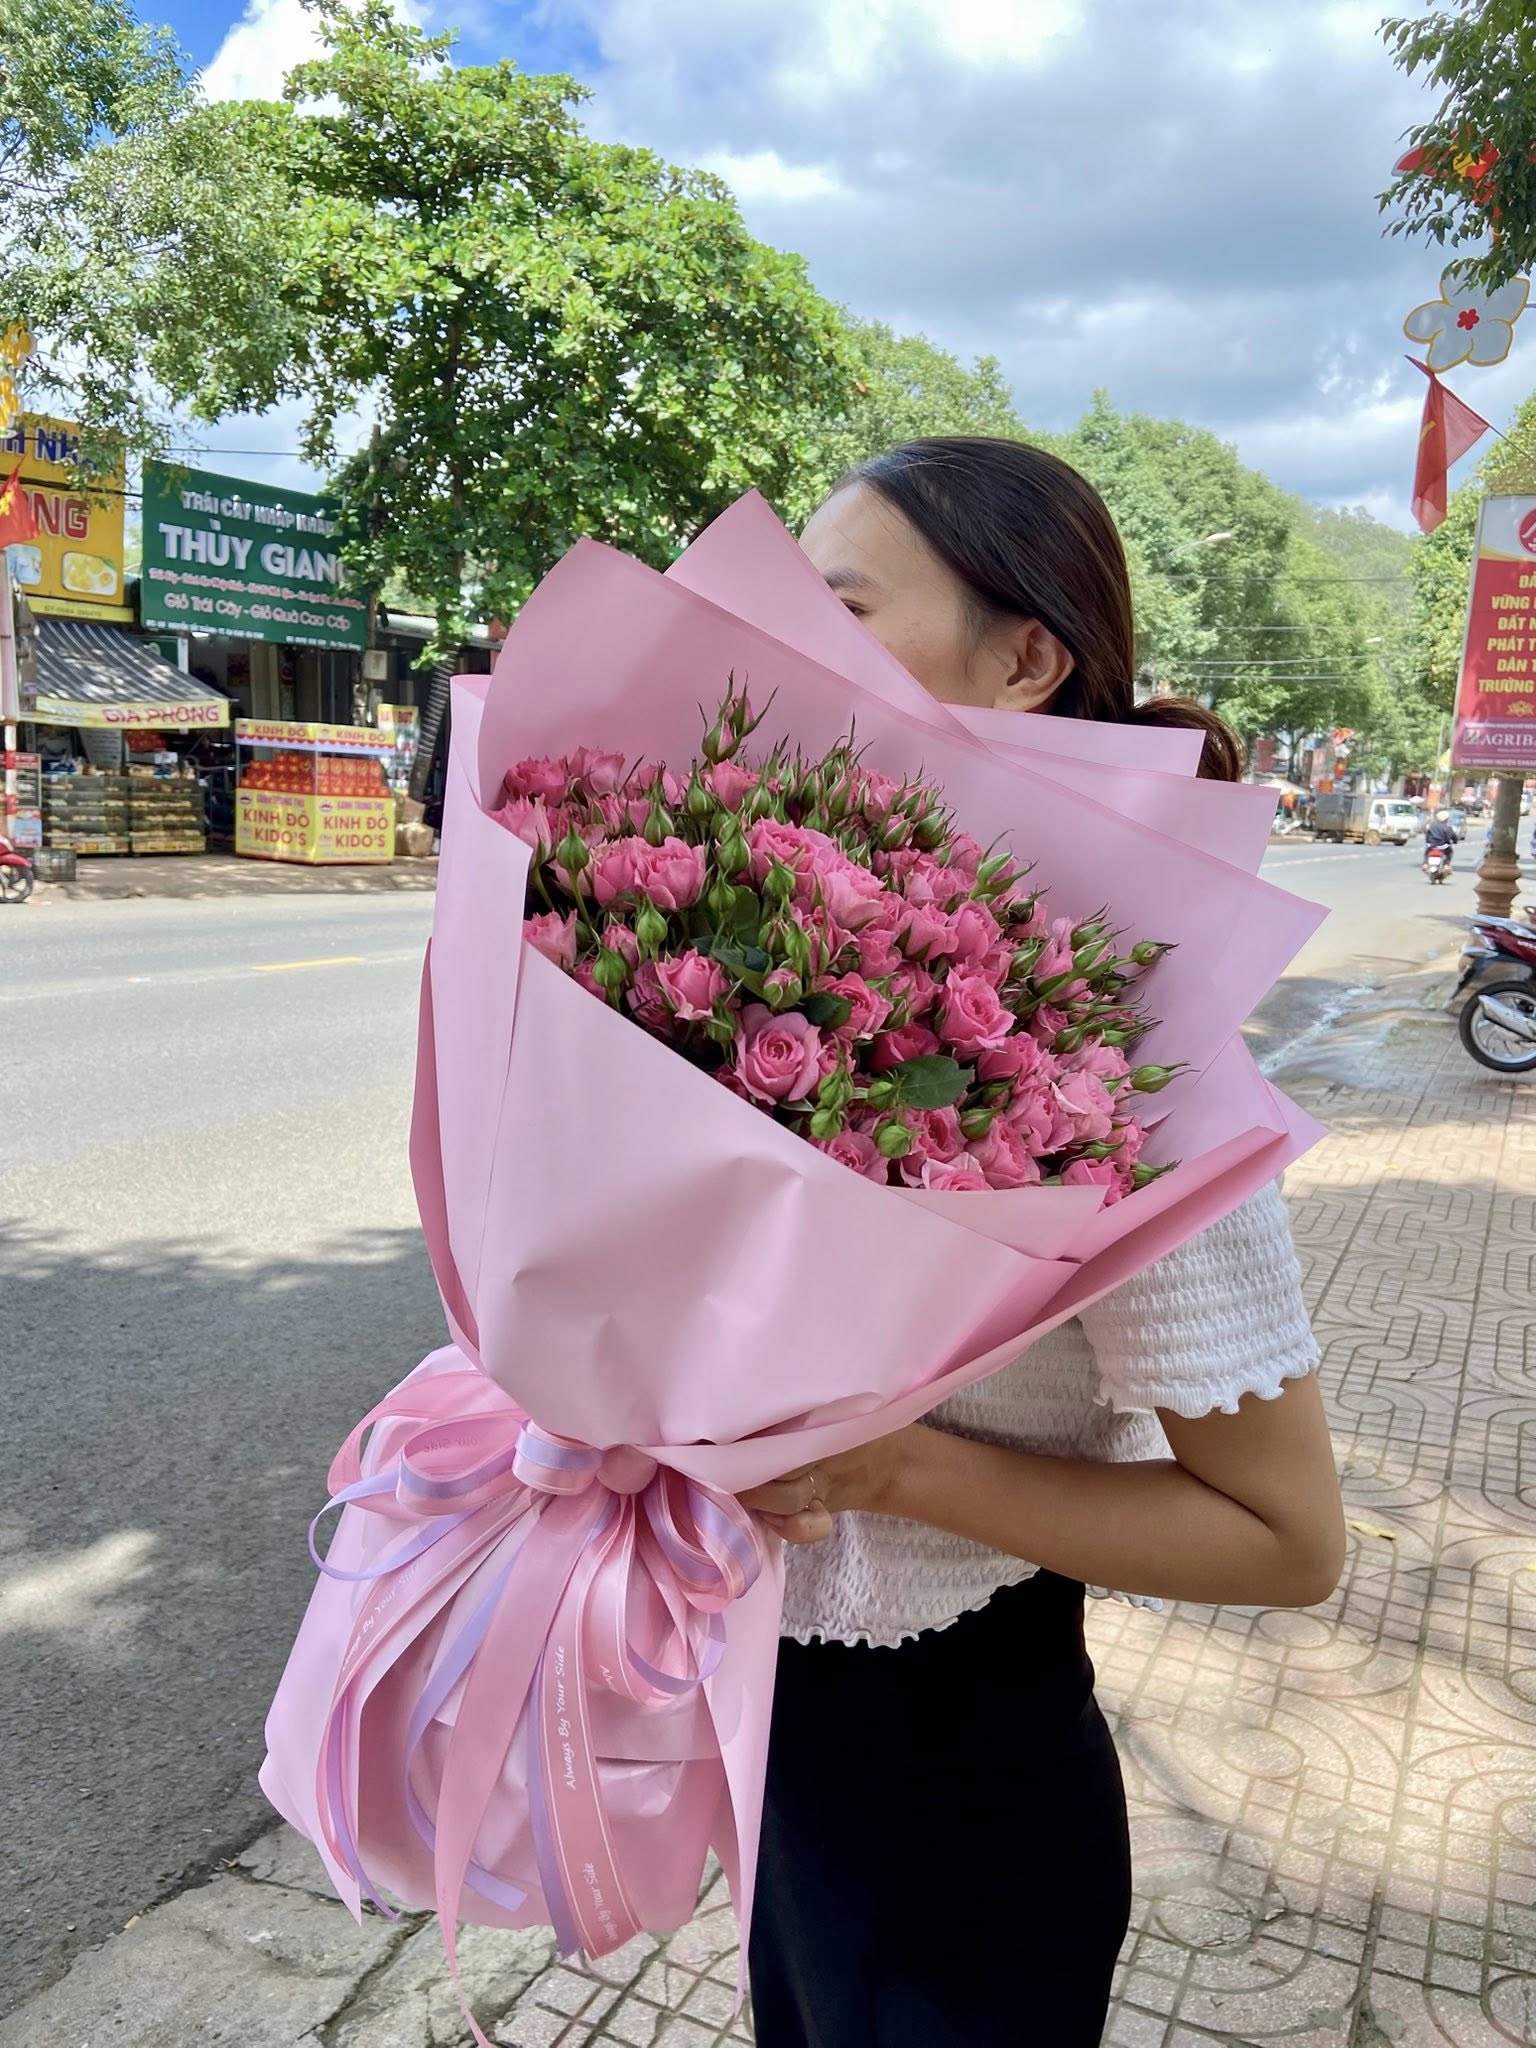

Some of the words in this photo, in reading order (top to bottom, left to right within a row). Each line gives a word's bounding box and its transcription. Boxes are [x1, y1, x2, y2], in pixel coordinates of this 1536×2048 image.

[182, 490, 219, 514] TRÁI
[1487, 635, 1525, 651] PHÁT
[102, 707, 141, 723] GIA
[254, 724, 284, 736] KINH
[336, 729, 365, 742] KINH
[243, 808, 280, 825] KINH
[324, 815, 361, 830] KINH
[555, 1645, 565, 1677] Side
[556, 1681, 566, 1713] Your
[558, 1718, 571, 1738] By
[562, 1743, 577, 1791] Always
